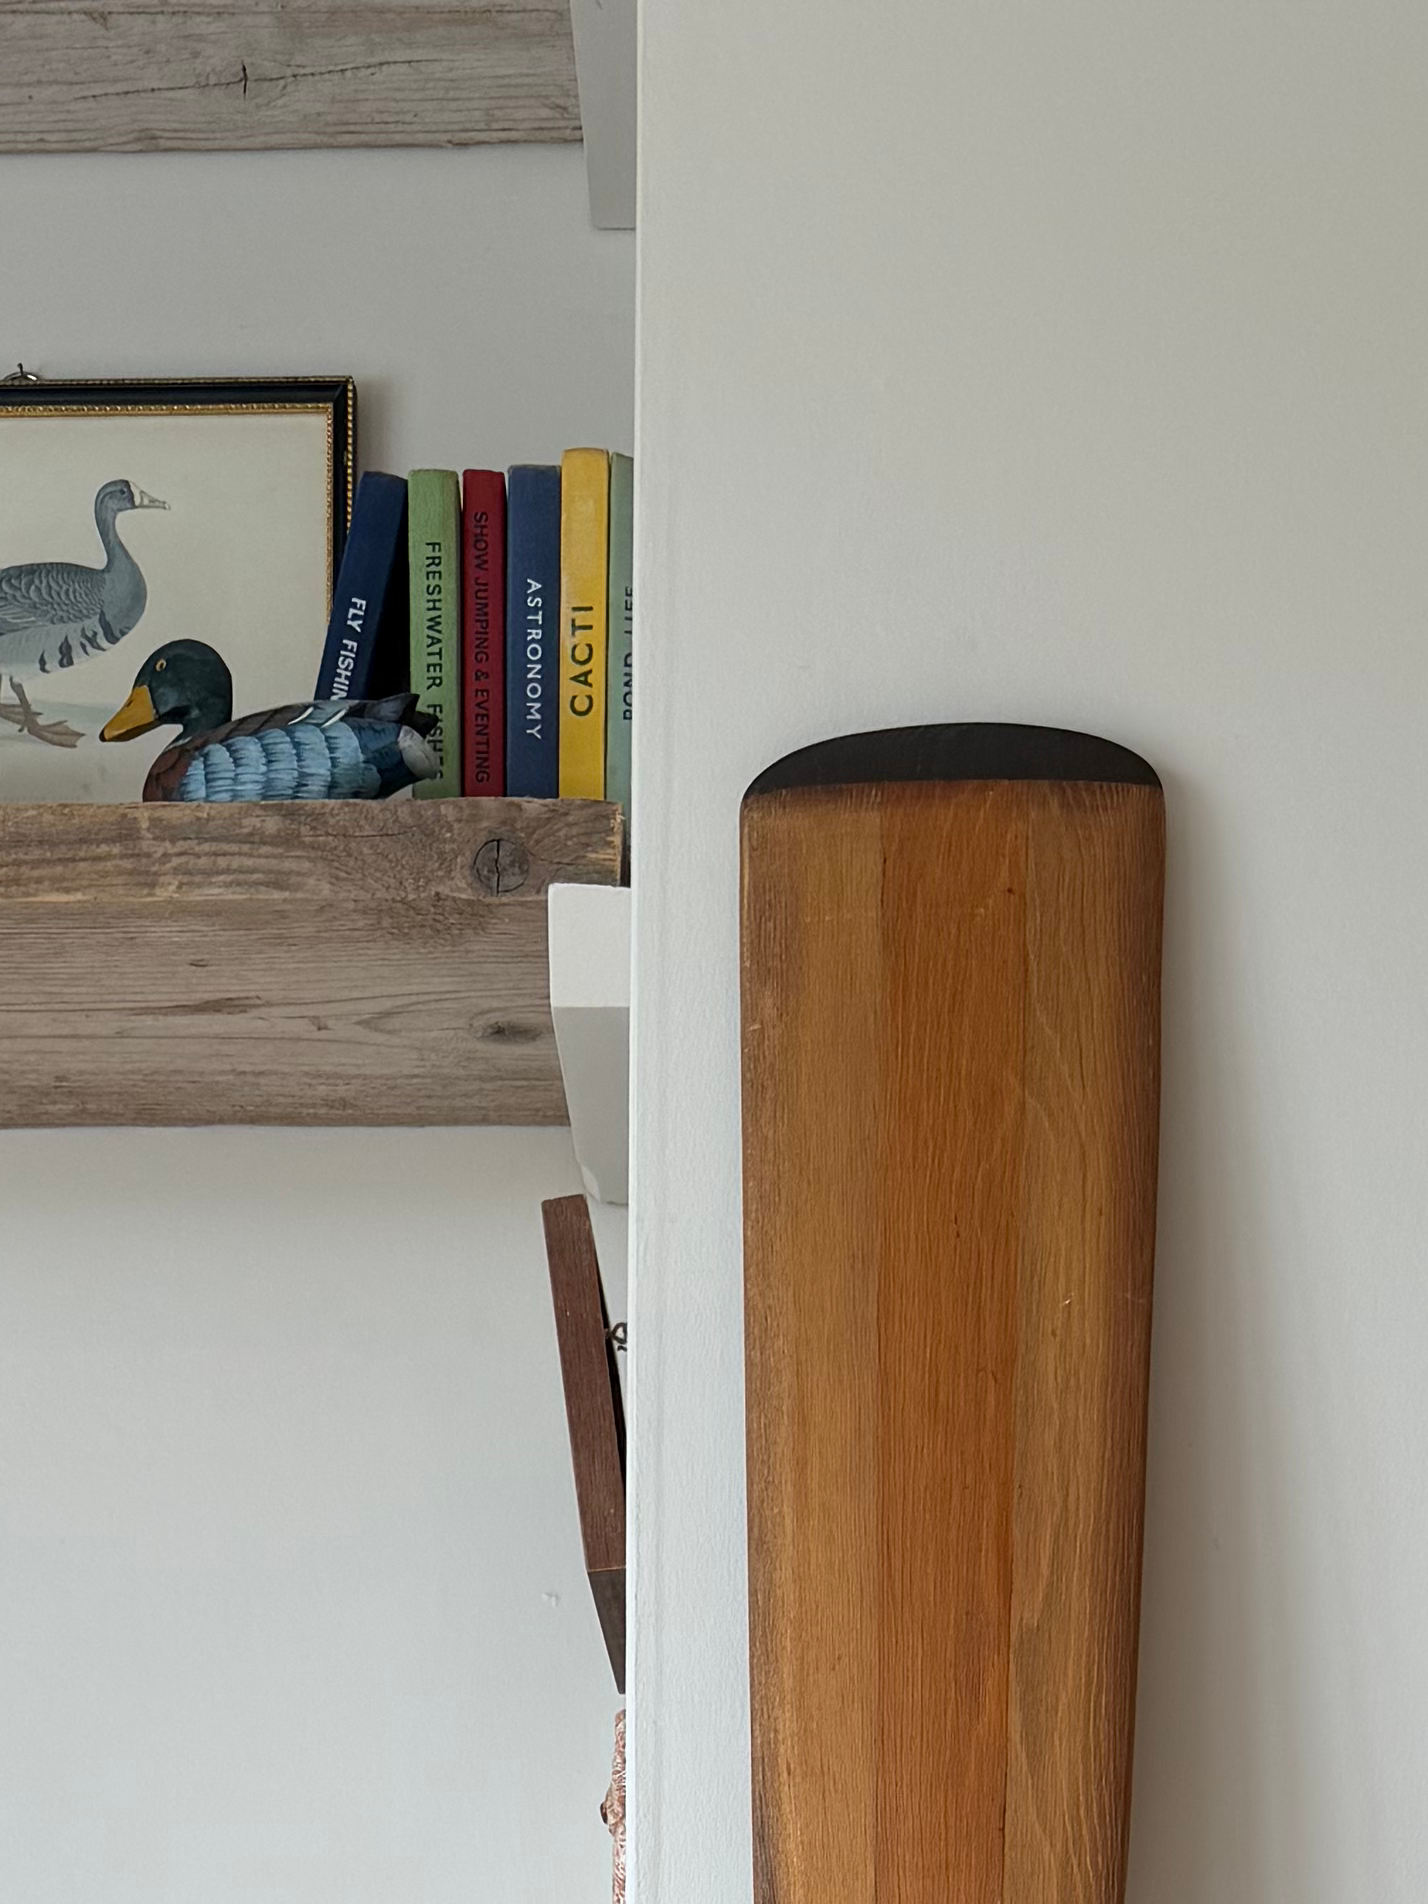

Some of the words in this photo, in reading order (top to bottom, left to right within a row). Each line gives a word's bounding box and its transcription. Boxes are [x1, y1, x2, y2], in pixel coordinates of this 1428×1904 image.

[474, 511, 489, 571] SHOW
[346, 597, 367, 633] FLY
[425, 541, 444, 691] FRESHWATER
[474, 578, 490, 663] JUMPING
[330, 639, 358, 701] FISHIN
[474, 671, 490, 681] &
[526, 578, 543, 740] ASTRONOMY
[569, 605, 594, 717] CACTI
[475, 688, 491, 784] EVENTING
